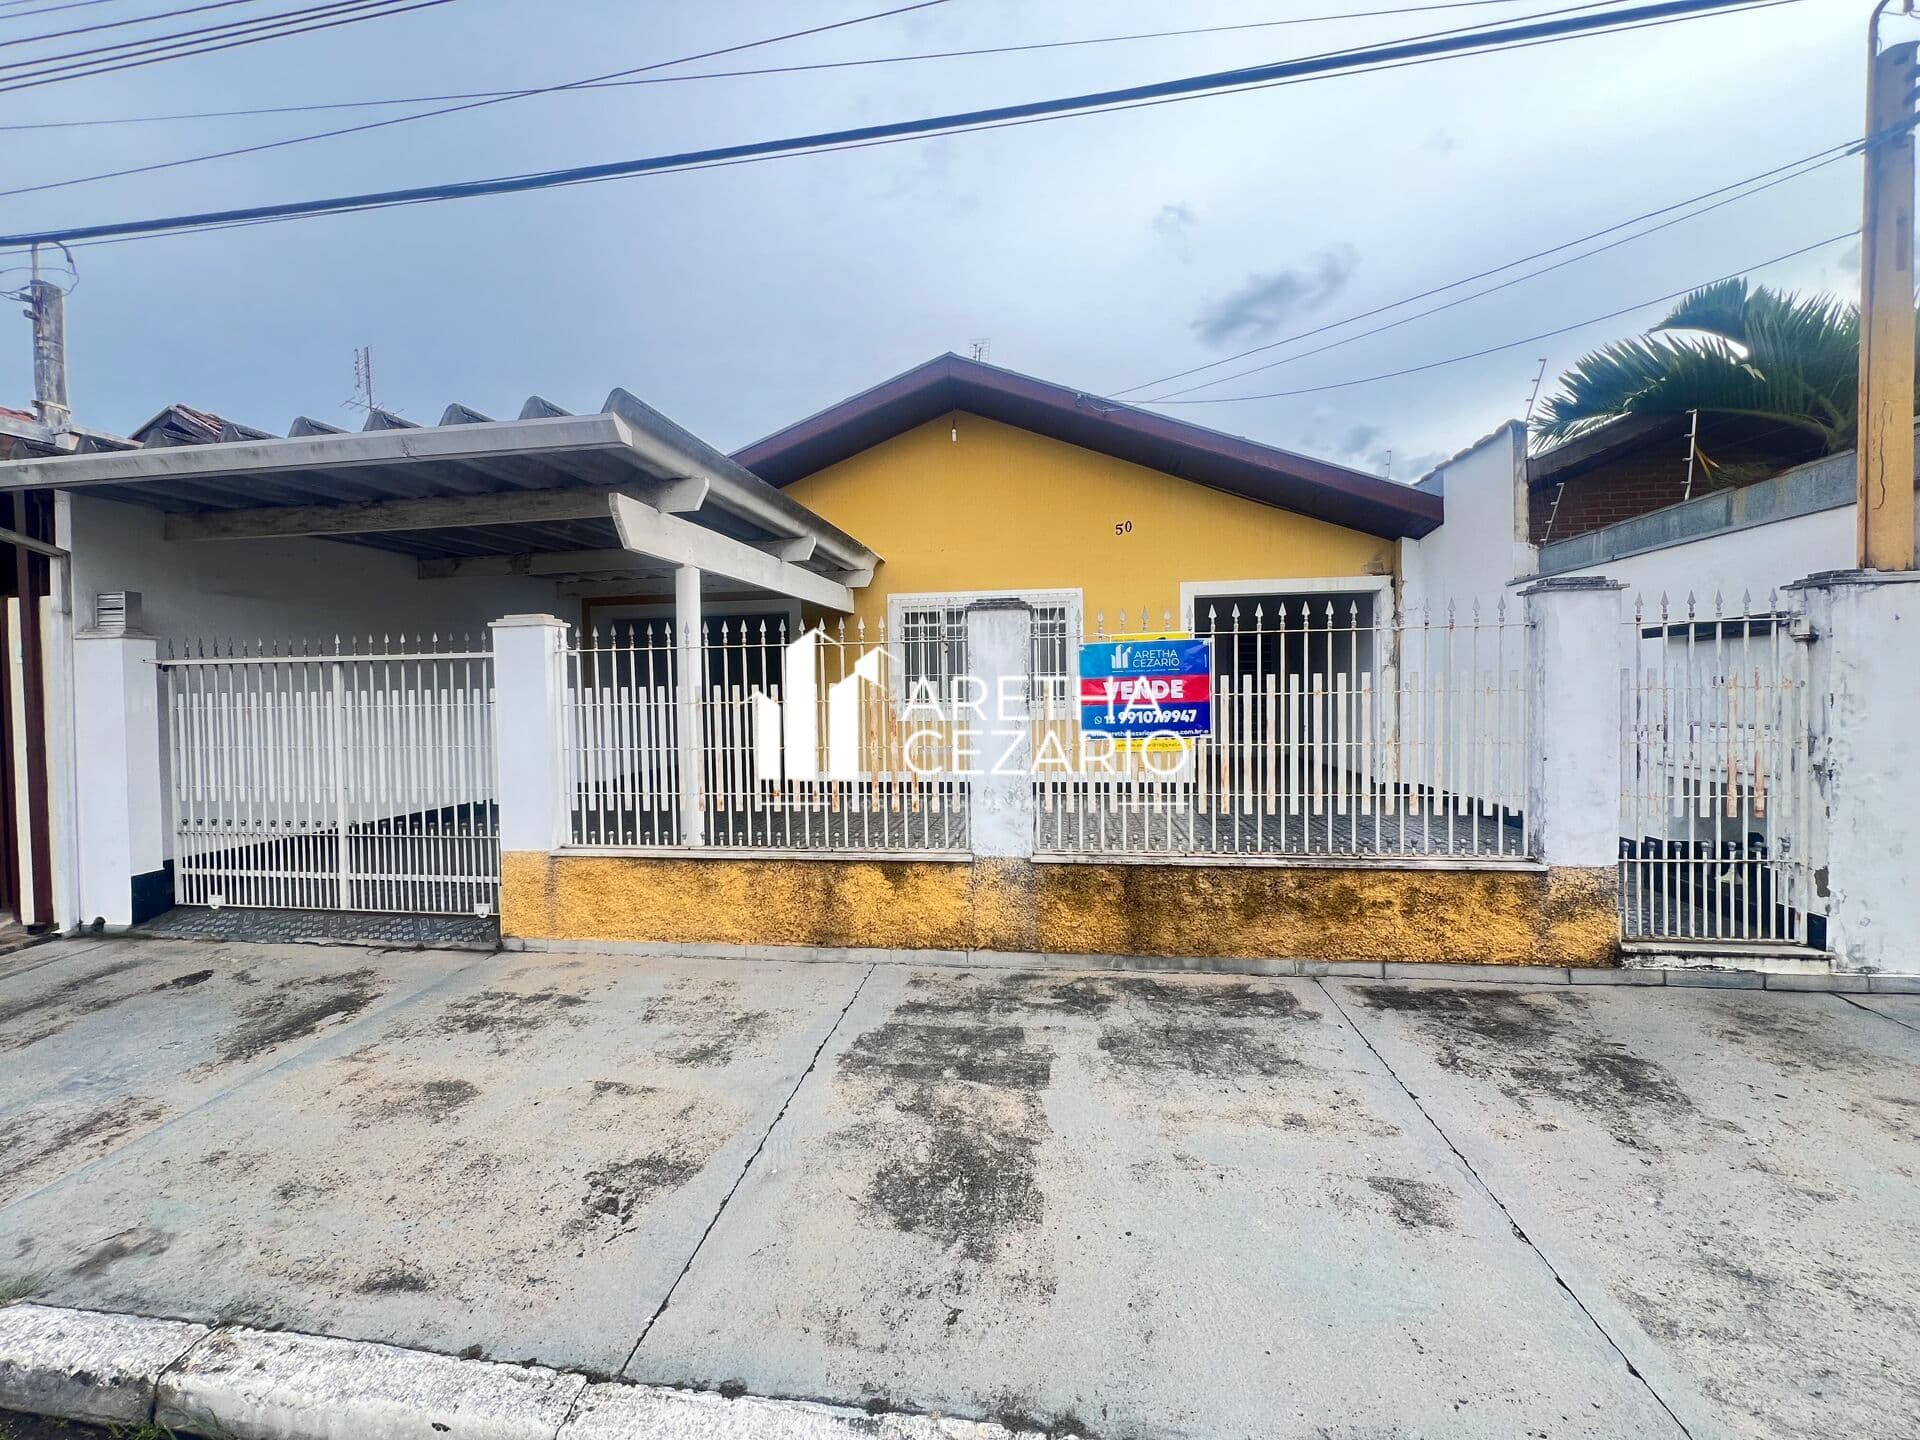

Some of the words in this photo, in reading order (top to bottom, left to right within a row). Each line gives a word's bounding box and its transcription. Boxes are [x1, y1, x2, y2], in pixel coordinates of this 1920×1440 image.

[1115, 520, 1132, 536] 50
[1134, 649, 1179, 659] ARETHA
[1132, 657, 1181, 668] CEZARIO
[1102, 679, 1185, 700] VENDE
